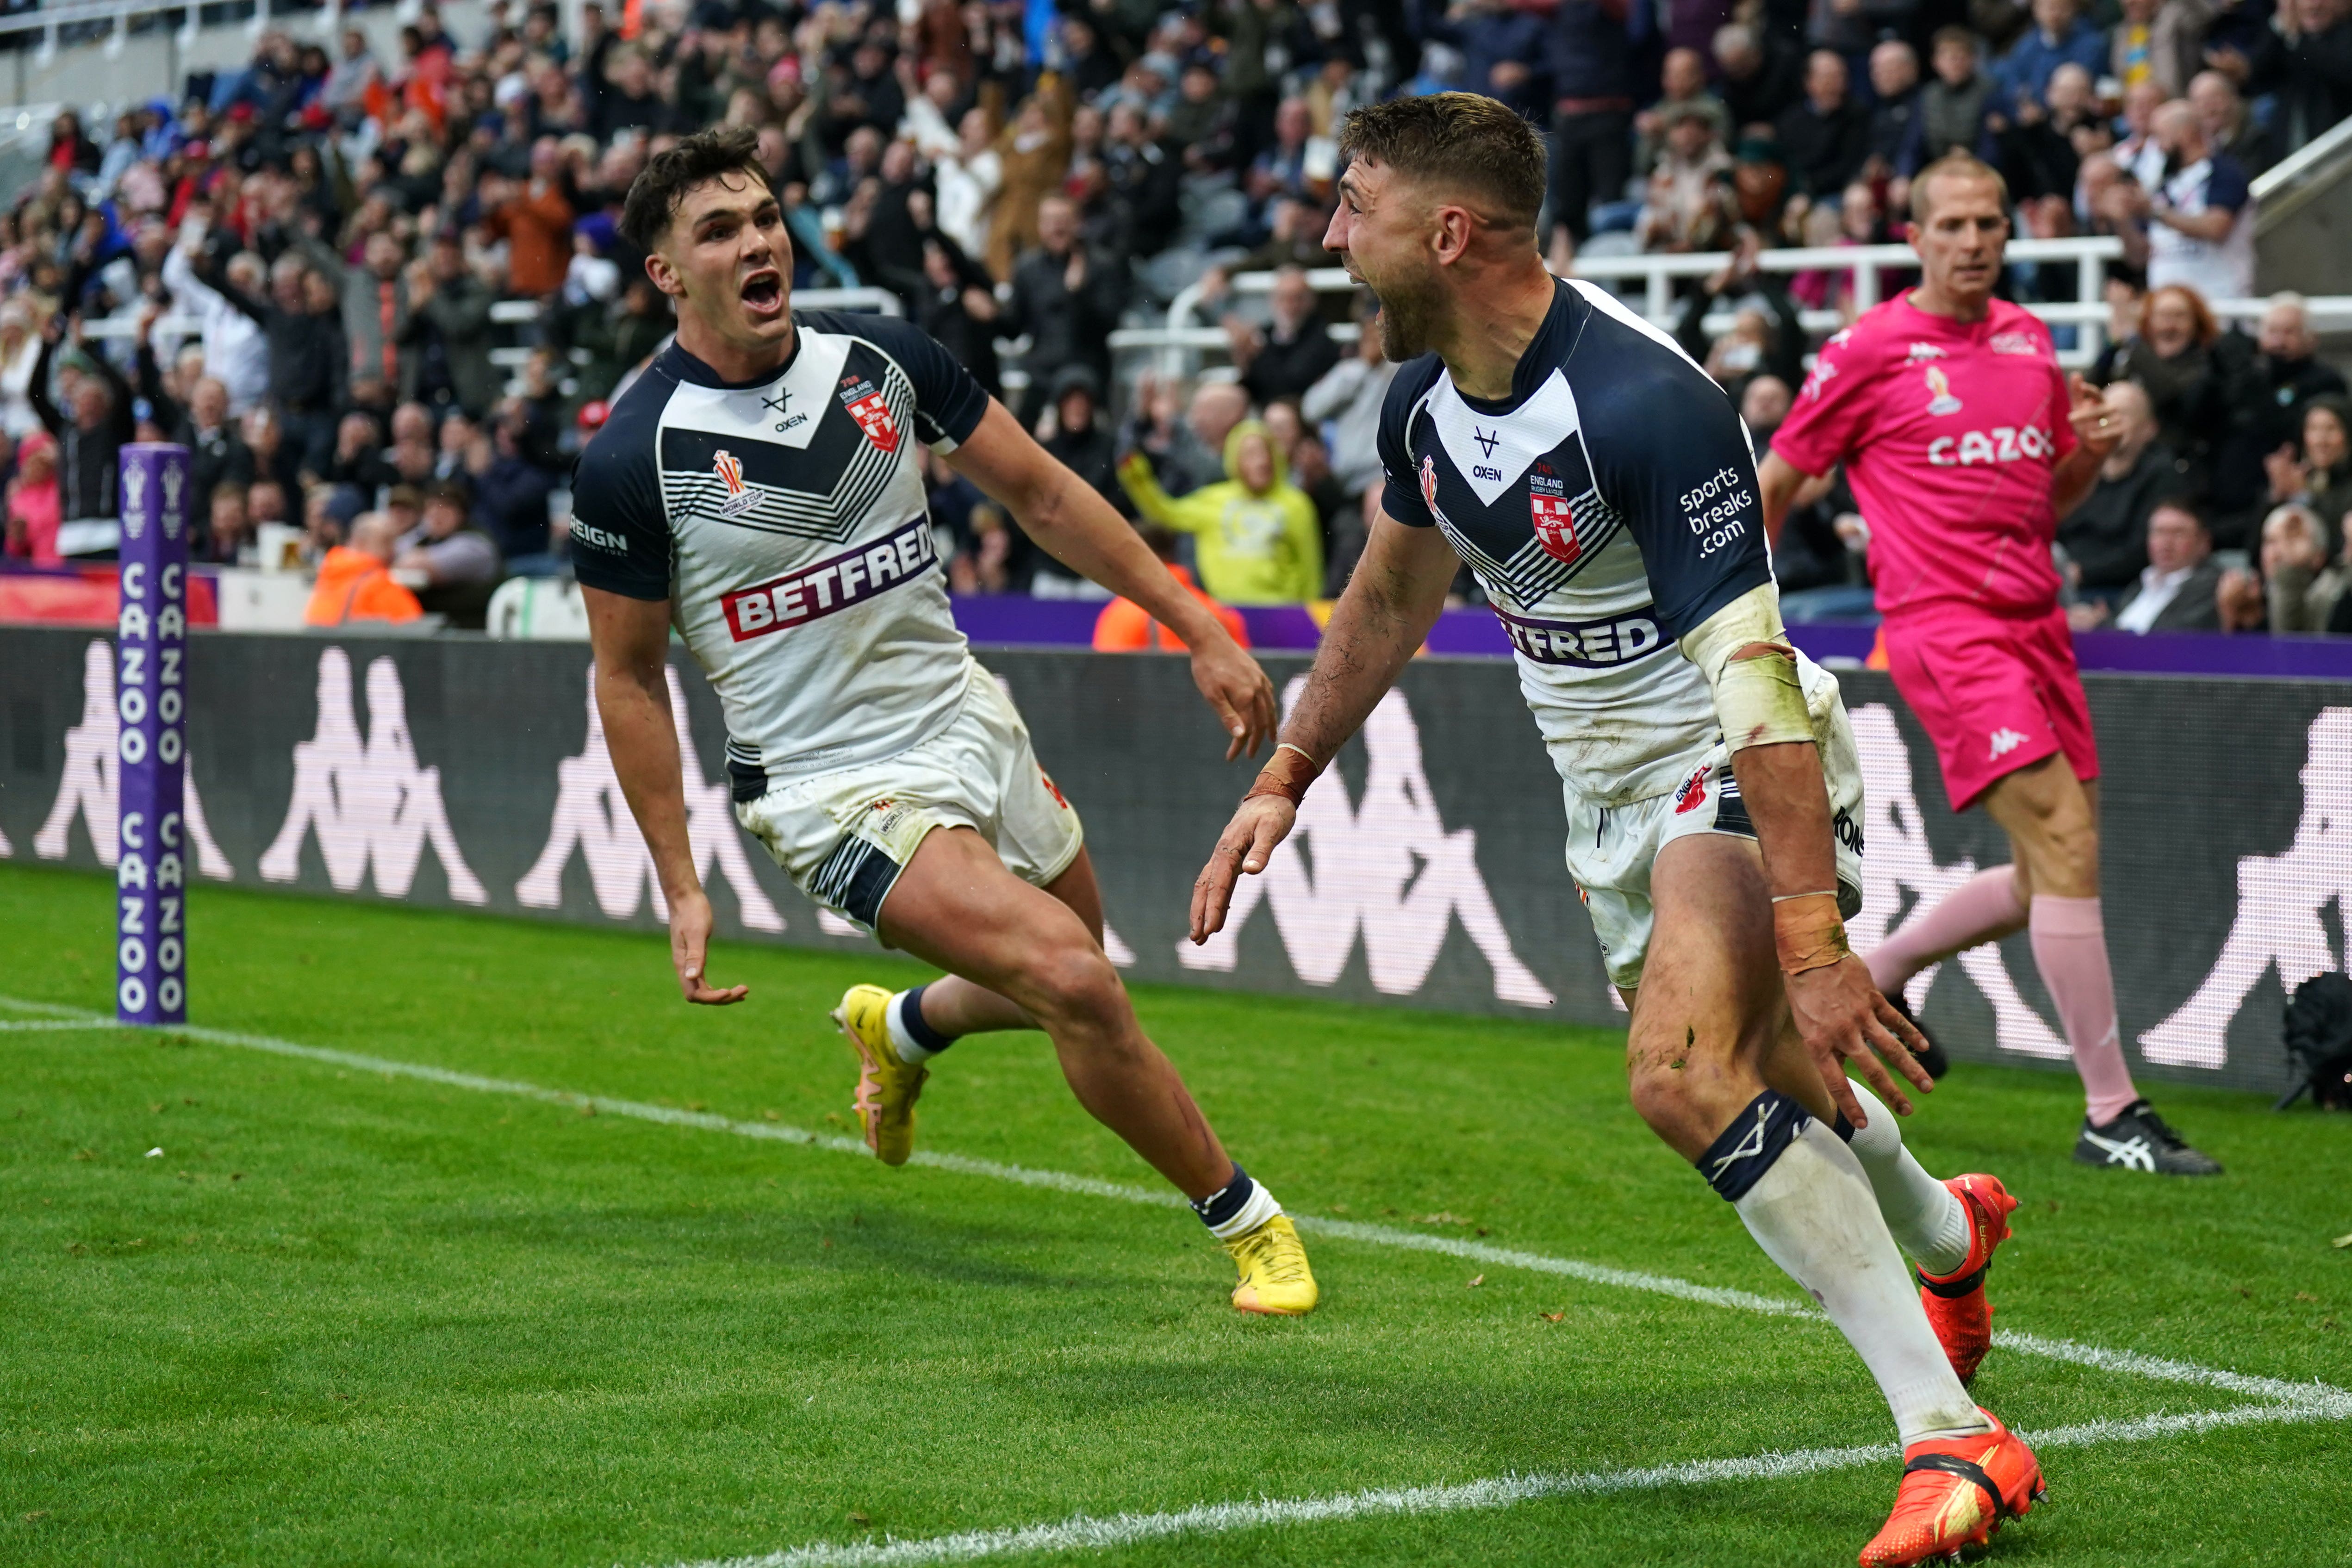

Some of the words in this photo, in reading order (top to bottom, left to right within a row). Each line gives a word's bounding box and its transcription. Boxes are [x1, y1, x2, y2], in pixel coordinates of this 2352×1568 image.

[839, 380, 873, 401] ENGLAND
[775, 412, 808, 433] OXEN
[1473, 465, 1501, 482] OXEN
[1530, 475, 1563, 490] ENGLAND
[1531, 485, 1546, 494] RUGBY
[1680, 467, 1739, 513] sports
[722, 498, 747, 514] WORLD
[749, 492, 763, 502] CUP
[1688, 489, 1752, 535] breaks
[570, 513, 628, 551] REIGN
[1700, 520, 1745, 559] .com
[735, 522, 934, 633] BETFRED
[119, 562, 150, 765] CAZOO
[156, 563, 184, 765] CAZOO
[881, 810, 903, 833] WORLD
[118, 811, 148, 1013] CAZOO
[156, 811, 183, 1013] CAZOO
